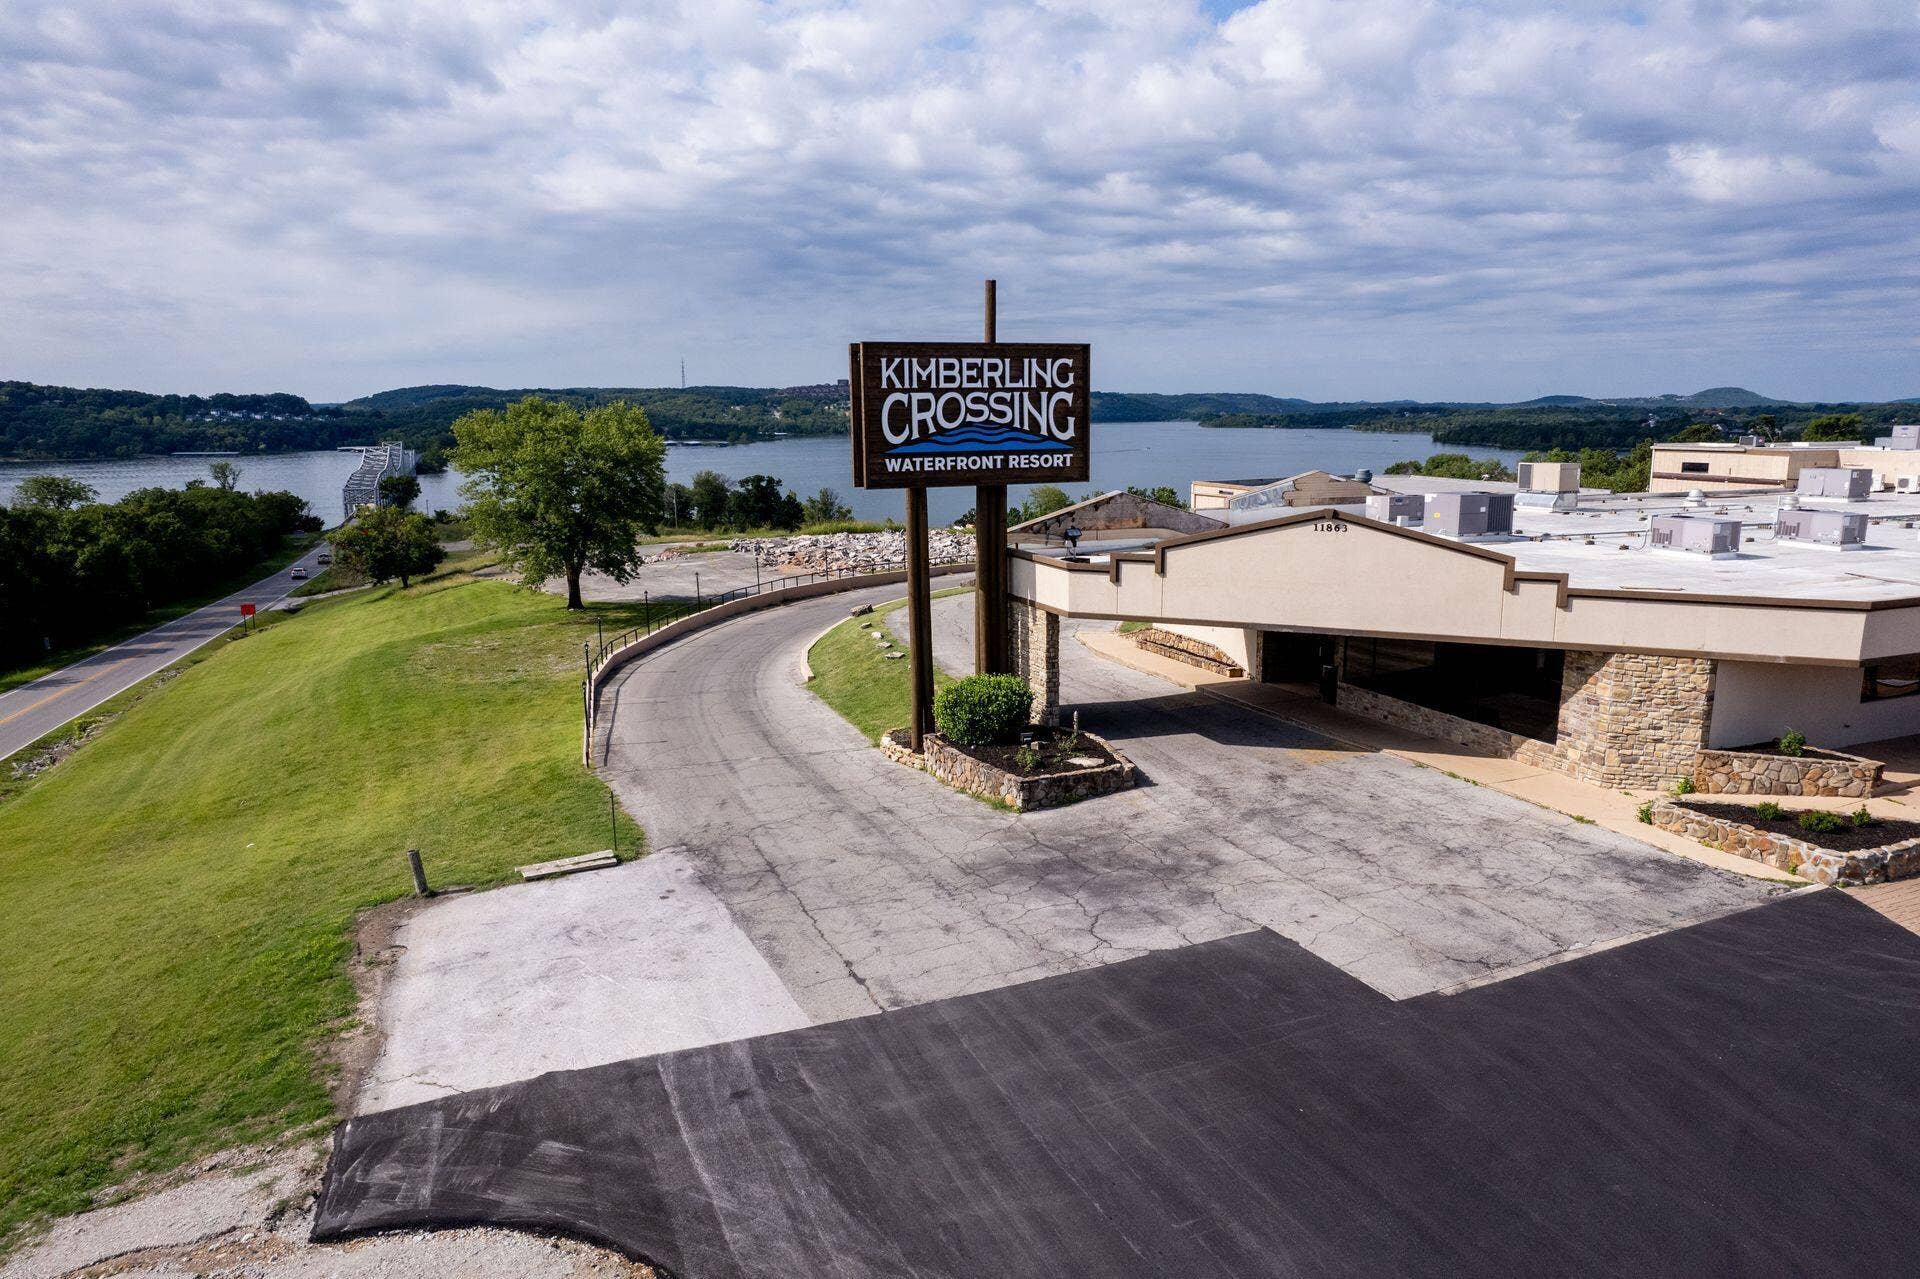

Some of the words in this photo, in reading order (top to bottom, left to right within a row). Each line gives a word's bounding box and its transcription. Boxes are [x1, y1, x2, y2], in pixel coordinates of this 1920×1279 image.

[881, 357, 1075, 389] KIMBERLING
[881, 391, 1076, 445] CROSSING
[884, 455, 1004, 472] WATERFRONT
[1008, 453, 1073, 469] RESORT
[1313, 523, 1348, 532] 11863
